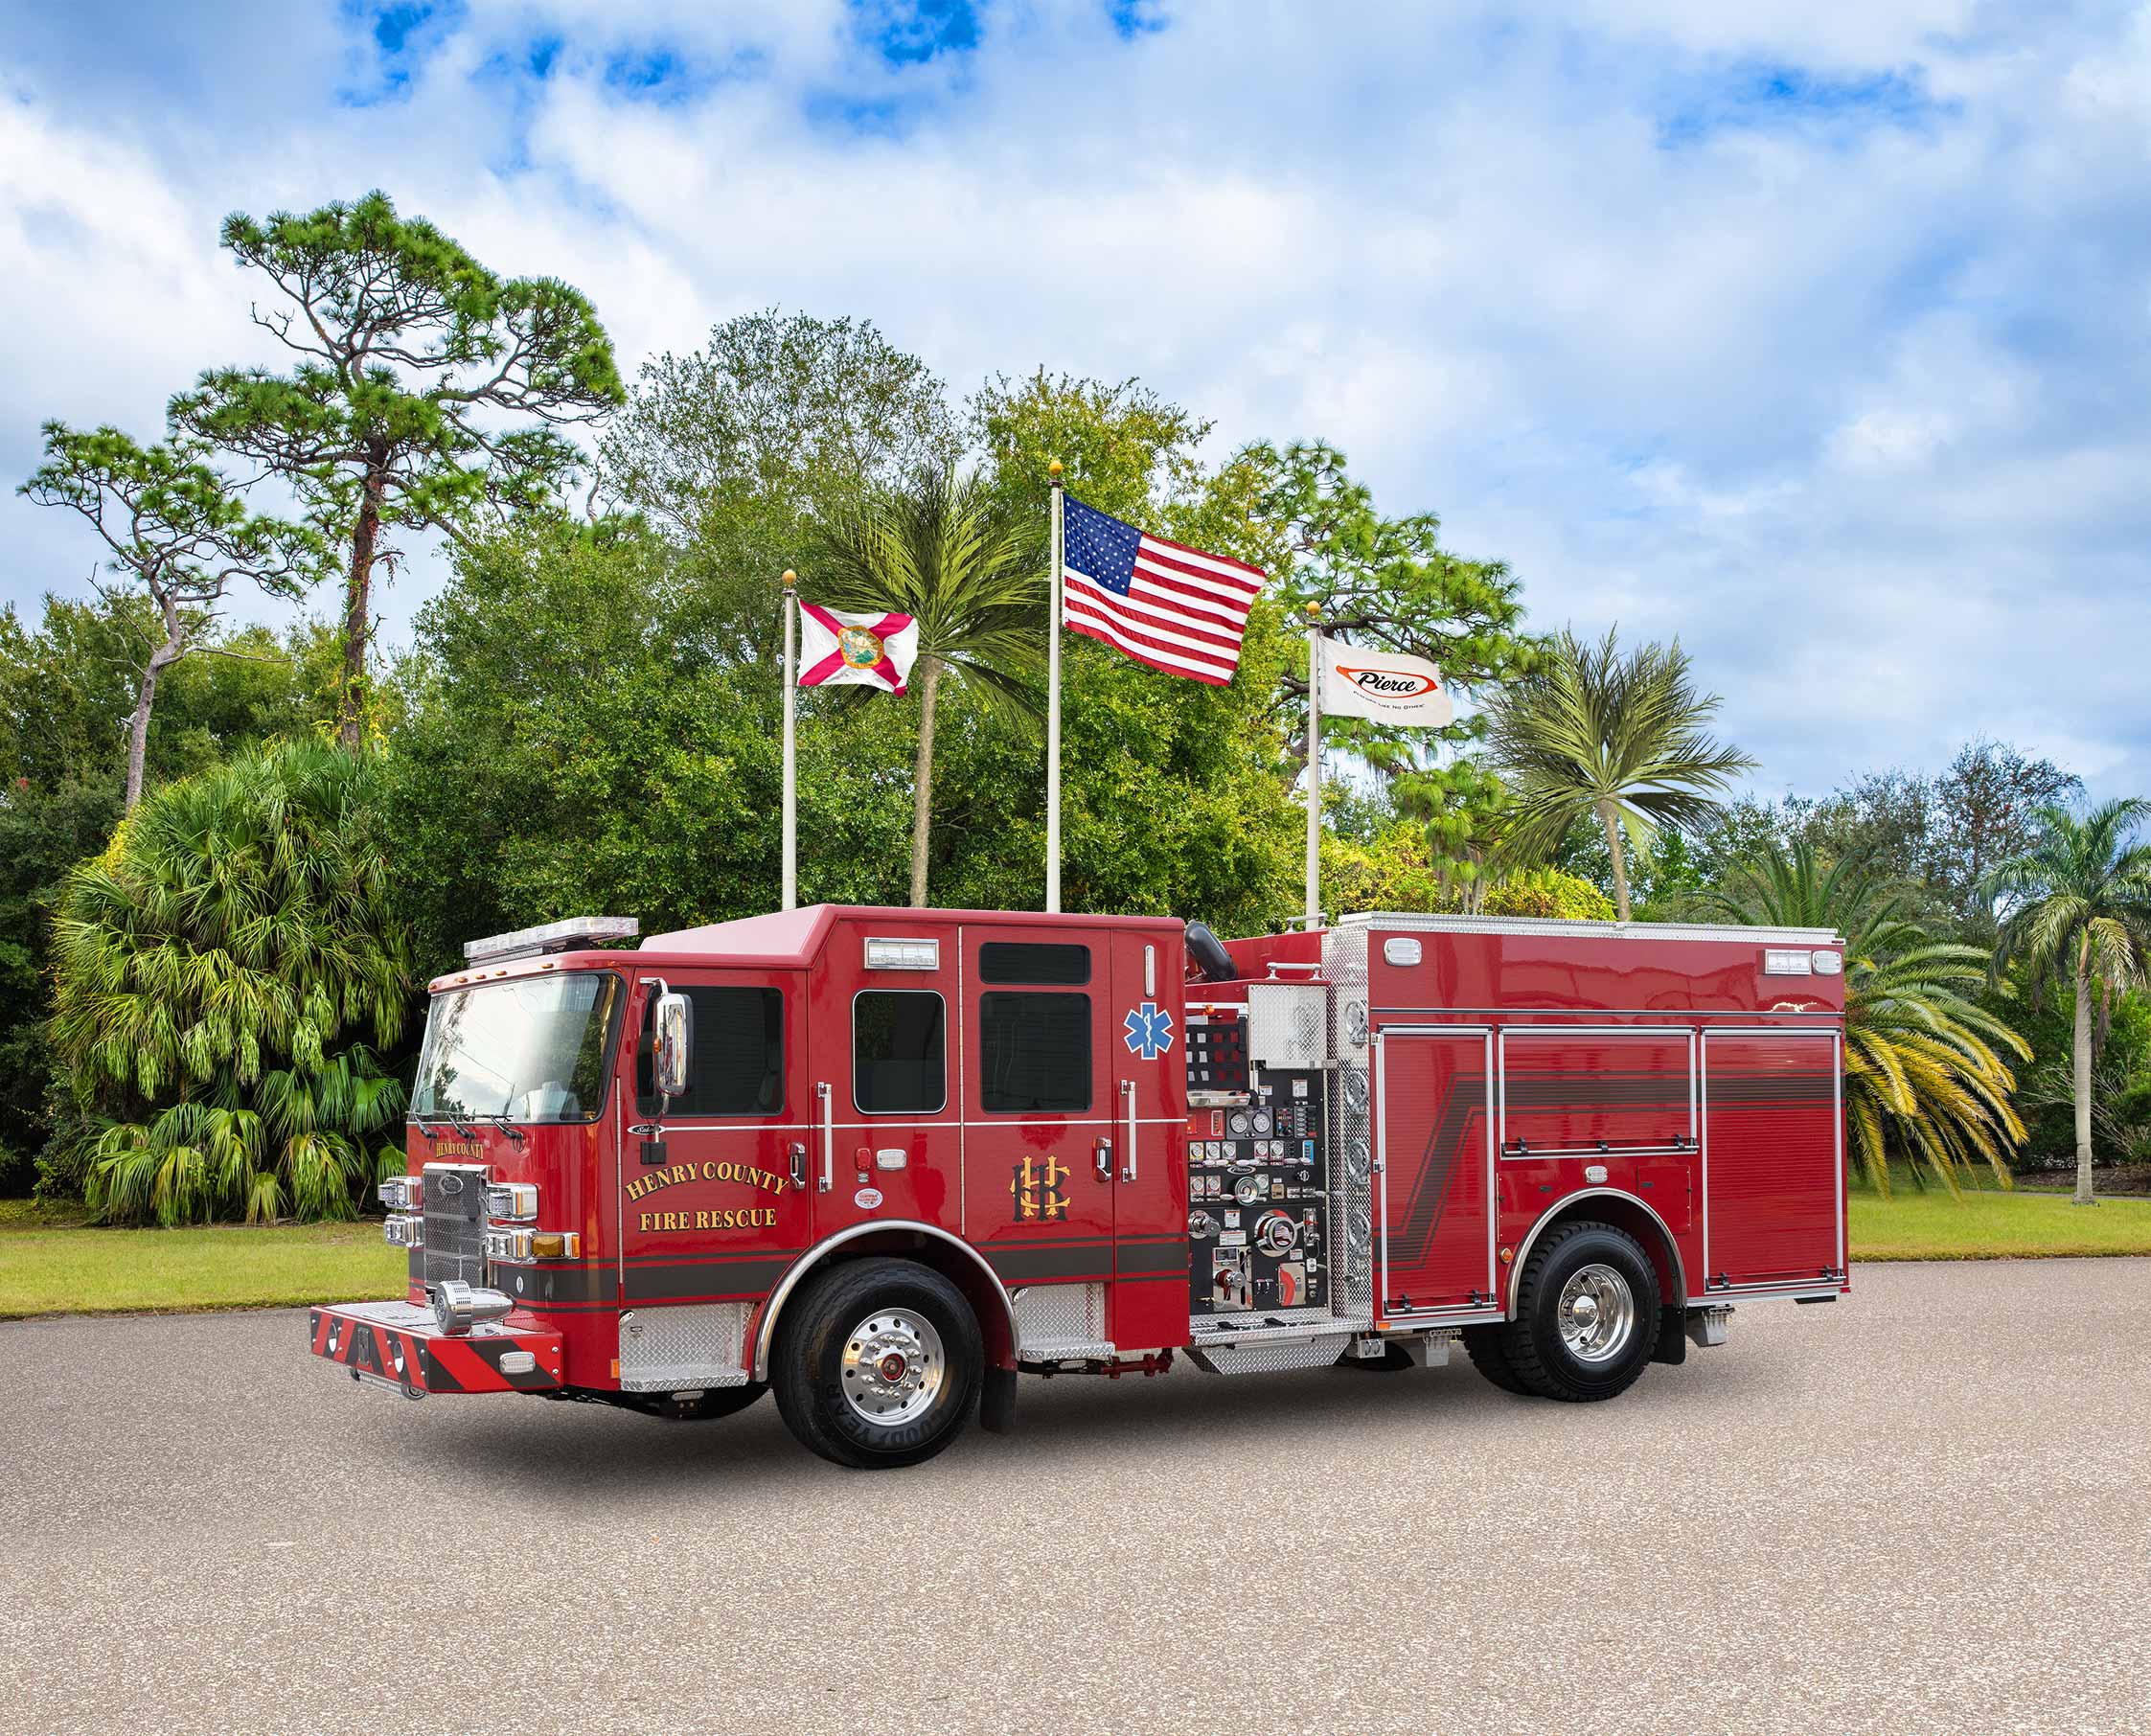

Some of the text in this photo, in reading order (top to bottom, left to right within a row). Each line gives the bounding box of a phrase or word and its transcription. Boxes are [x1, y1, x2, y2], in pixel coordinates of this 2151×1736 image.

[1358, 673, 1416, 692] Pierce
[436, 1143, 484, 1160] HENRY COUNTY
[626, 1161, 789, 1202] HENRY COUNTY
[639, 1208, 777, 1232] FIRE RESCUE
